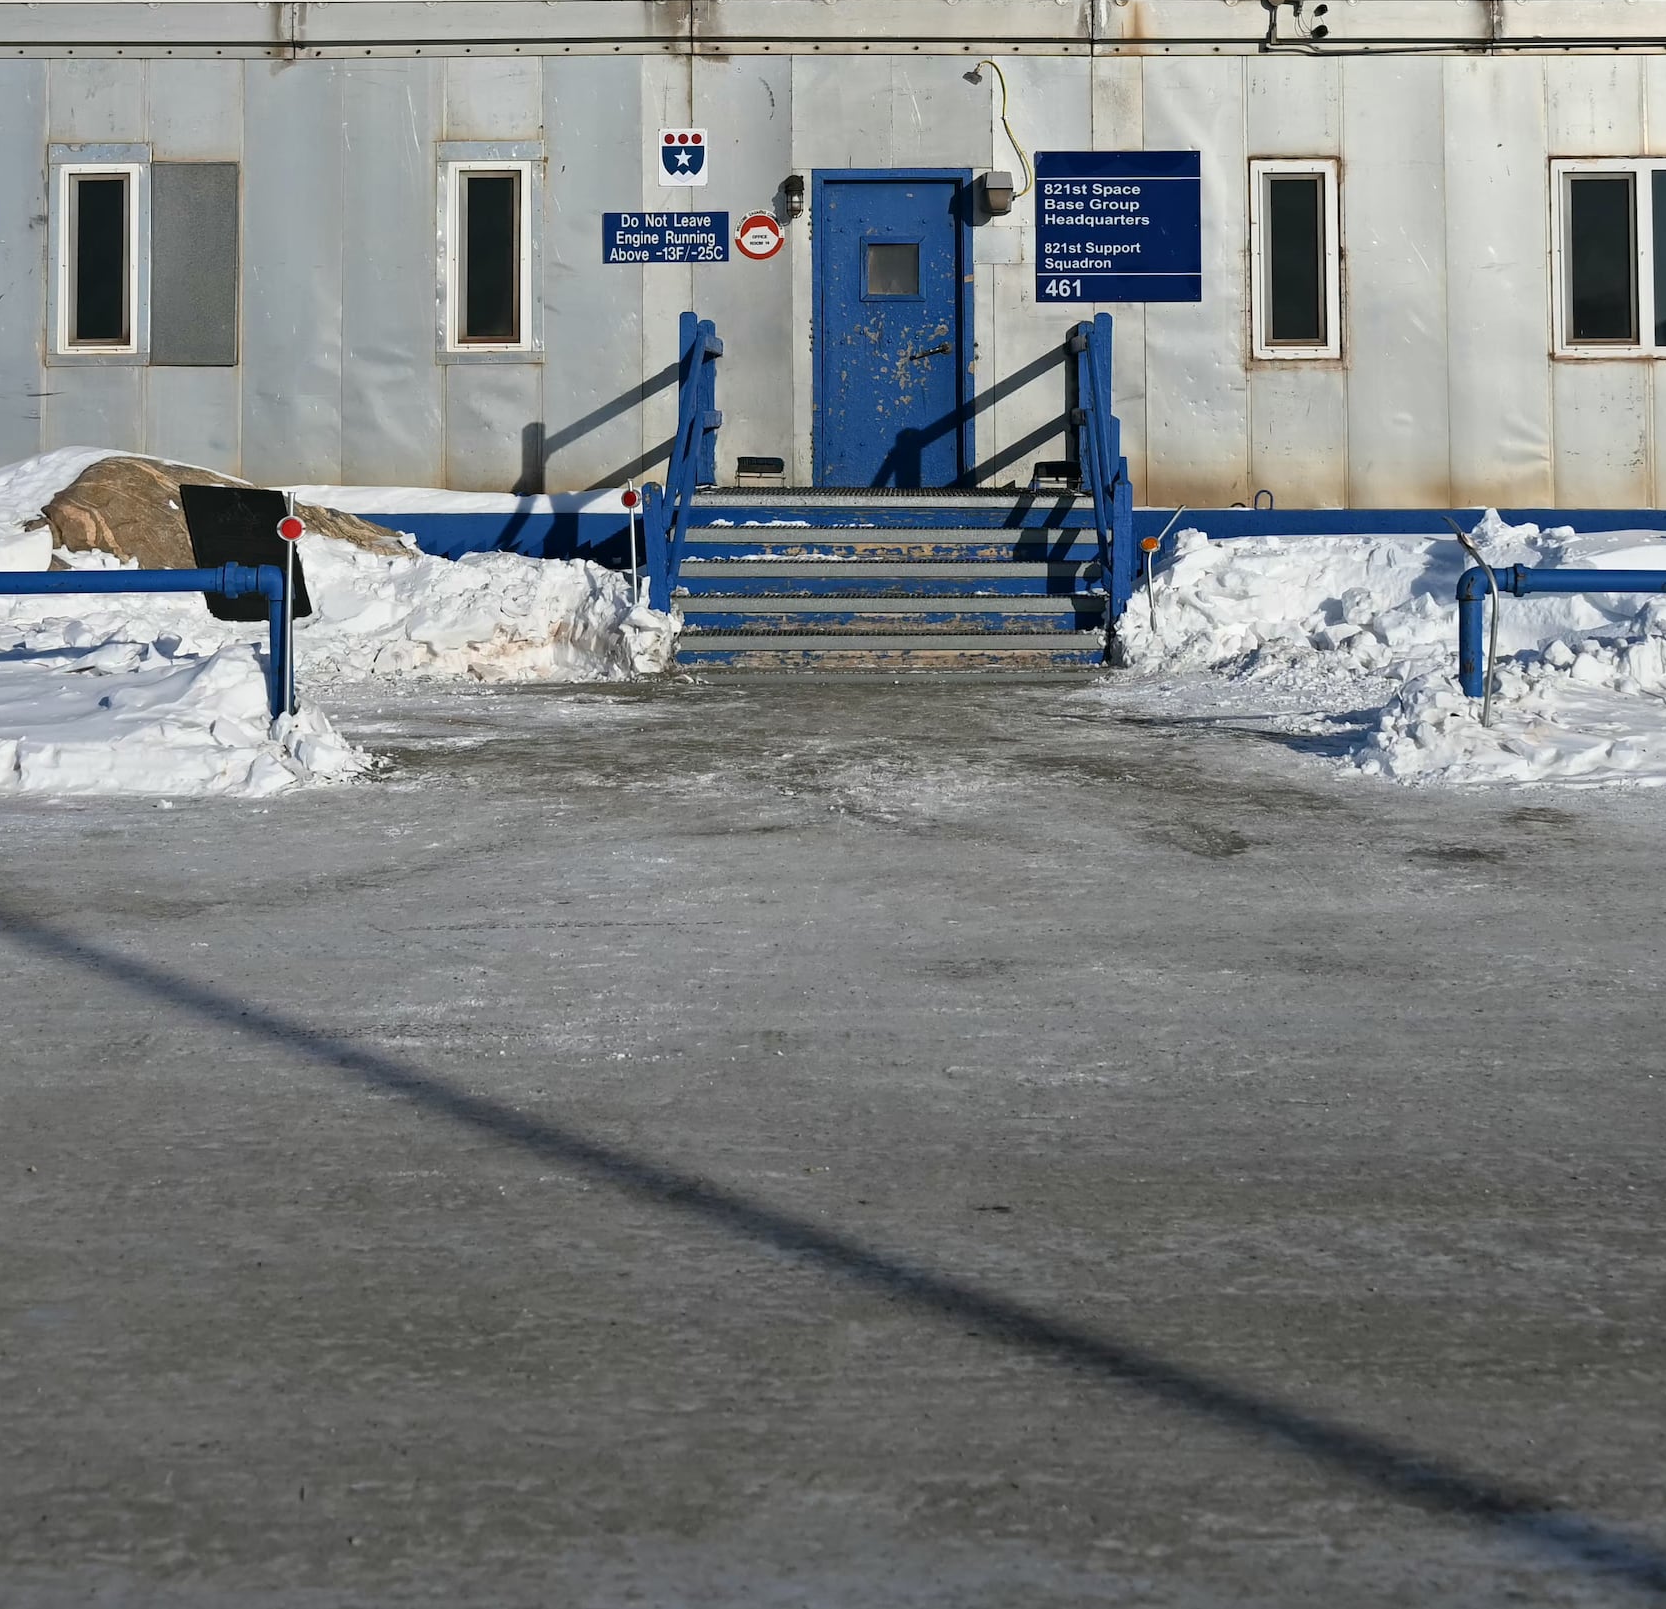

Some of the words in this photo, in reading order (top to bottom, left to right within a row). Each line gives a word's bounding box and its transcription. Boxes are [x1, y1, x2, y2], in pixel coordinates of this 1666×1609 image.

[1044, 183, 1088, 195] 821st
[1091, 183, 1141, 197] Space
[1044, 198, 1085, 210] Base
[1089, 198, 1140, 212] Group
[621, 213, 639, 228] Do
[645, 213, 668, 228] Not
[673, 213, 712, 228] Leave
[1044, 213, 1150, 227] Headquarters
[616, 230, 659, 247] Engine
[665, 229, 716, 247] Running
[609, 247, 649, 261] Above
[655, 245, 724, 262] -13F/-25C
[1044, 242, 1082, 254] 821st
[1085, 242, 1141, 256] Support
[1044, 257, 1112, 271] Squadron
[1045, 278, 1081, 297] 461
